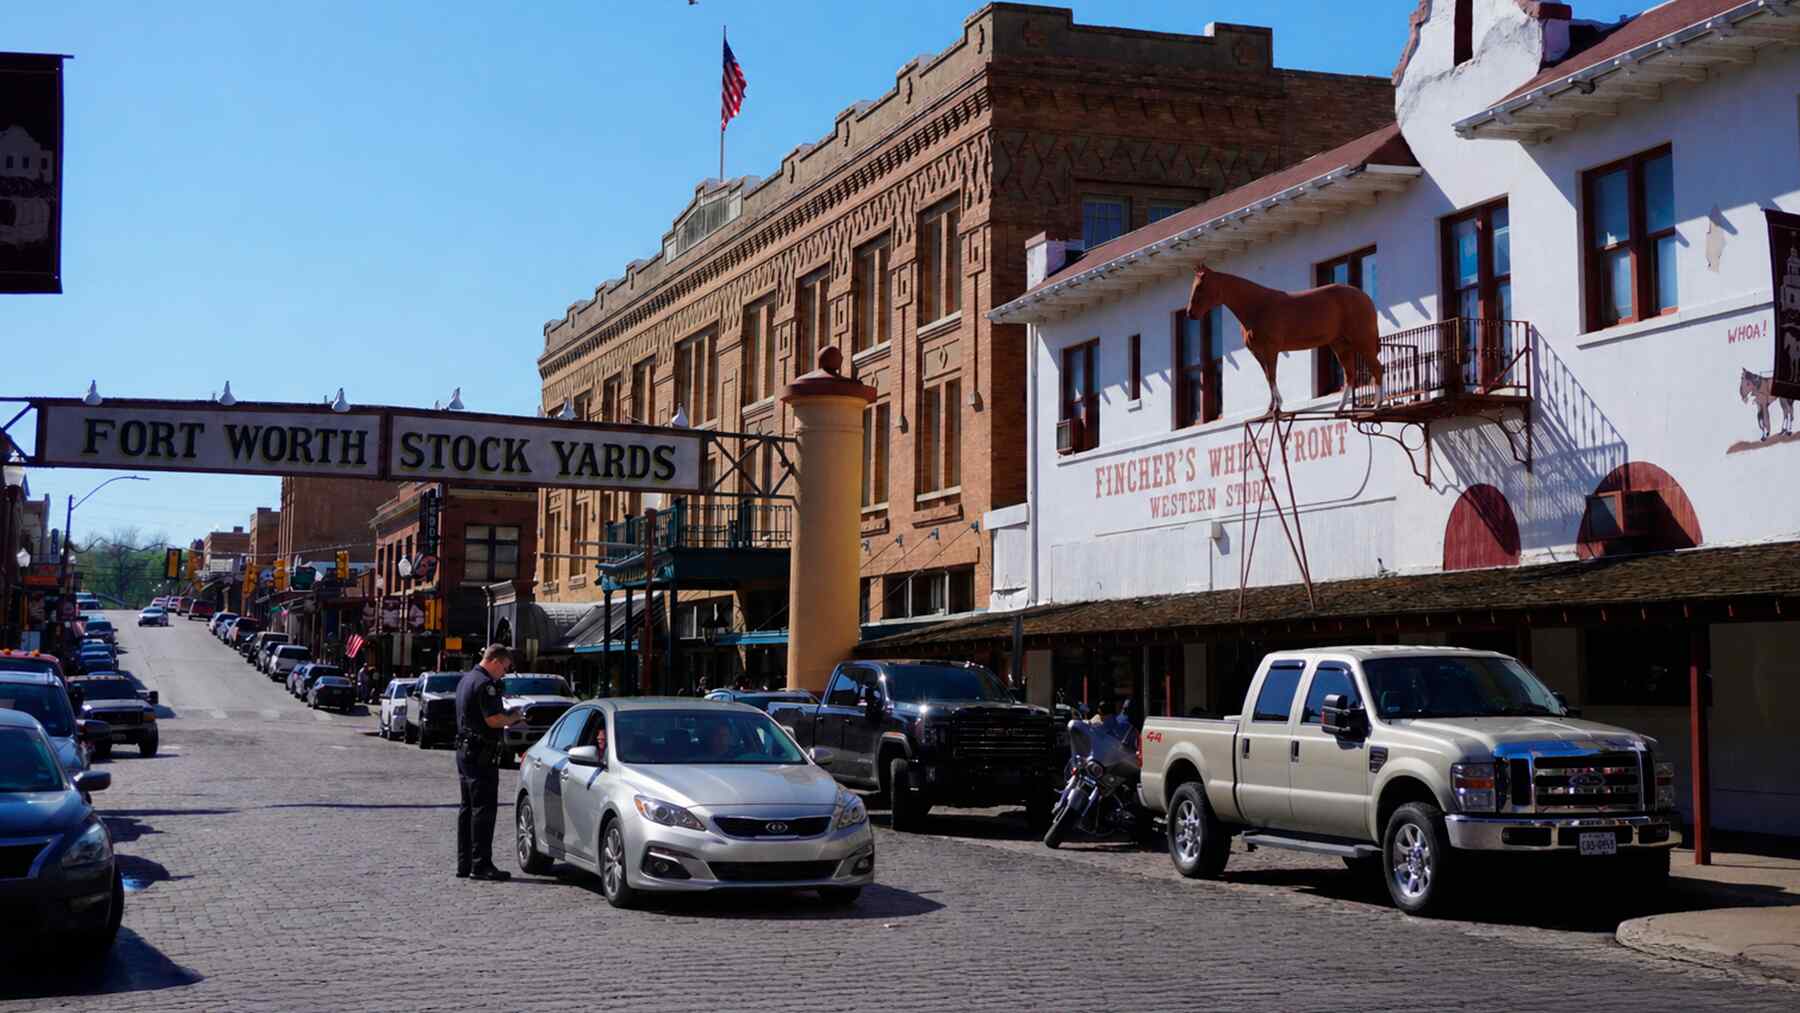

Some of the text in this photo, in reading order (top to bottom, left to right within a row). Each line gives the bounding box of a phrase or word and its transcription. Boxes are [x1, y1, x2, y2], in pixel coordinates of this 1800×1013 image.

[1728, 320, 1767, 344] WHOA!
[80, 418, 677, 481] FORT WORTH STOCK YARDS
[1095, 421, 1348, 499] FINCHER'S WHITE FRONT
[1150, 487, 1216, 519] WESTERN
